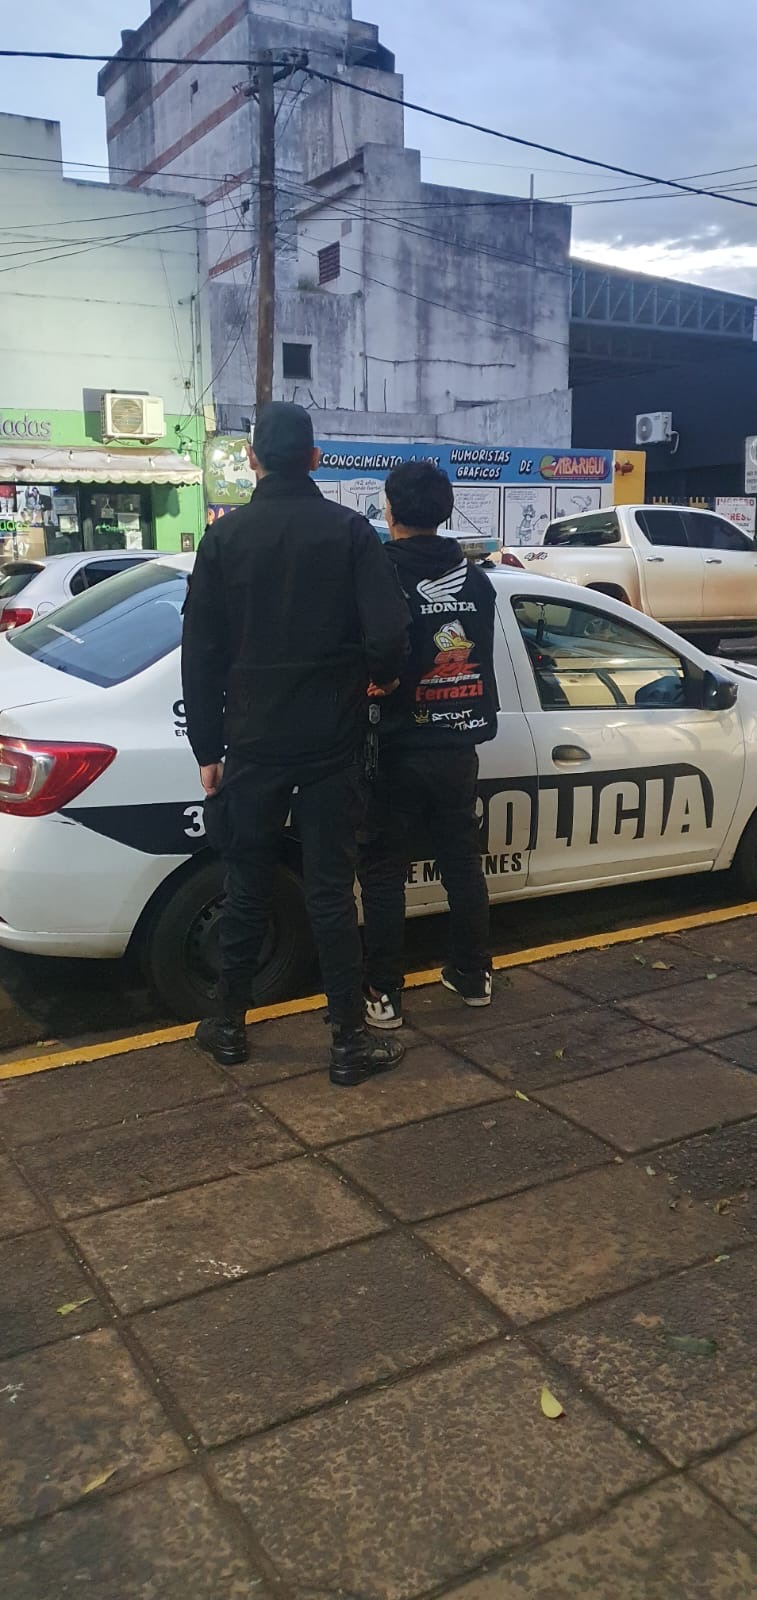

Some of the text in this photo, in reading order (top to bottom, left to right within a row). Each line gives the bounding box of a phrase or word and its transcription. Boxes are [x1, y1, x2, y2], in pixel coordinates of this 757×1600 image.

[0, 412, 51, 437] adas
[319, 454, 402, 468] CONOCIMIENTO
[451, 449, 510, 462] HUMORISTAS
[457, 466, 501, 478] GRAFICOS
[520, 459, 531, 472] DE
[420, 601, 478, 615] HONDA
[415, 680, 483, 702] Ferrazzi
[432, 709, 473, 721] STUNT
[475, 774, 706, 854] OLICIA
